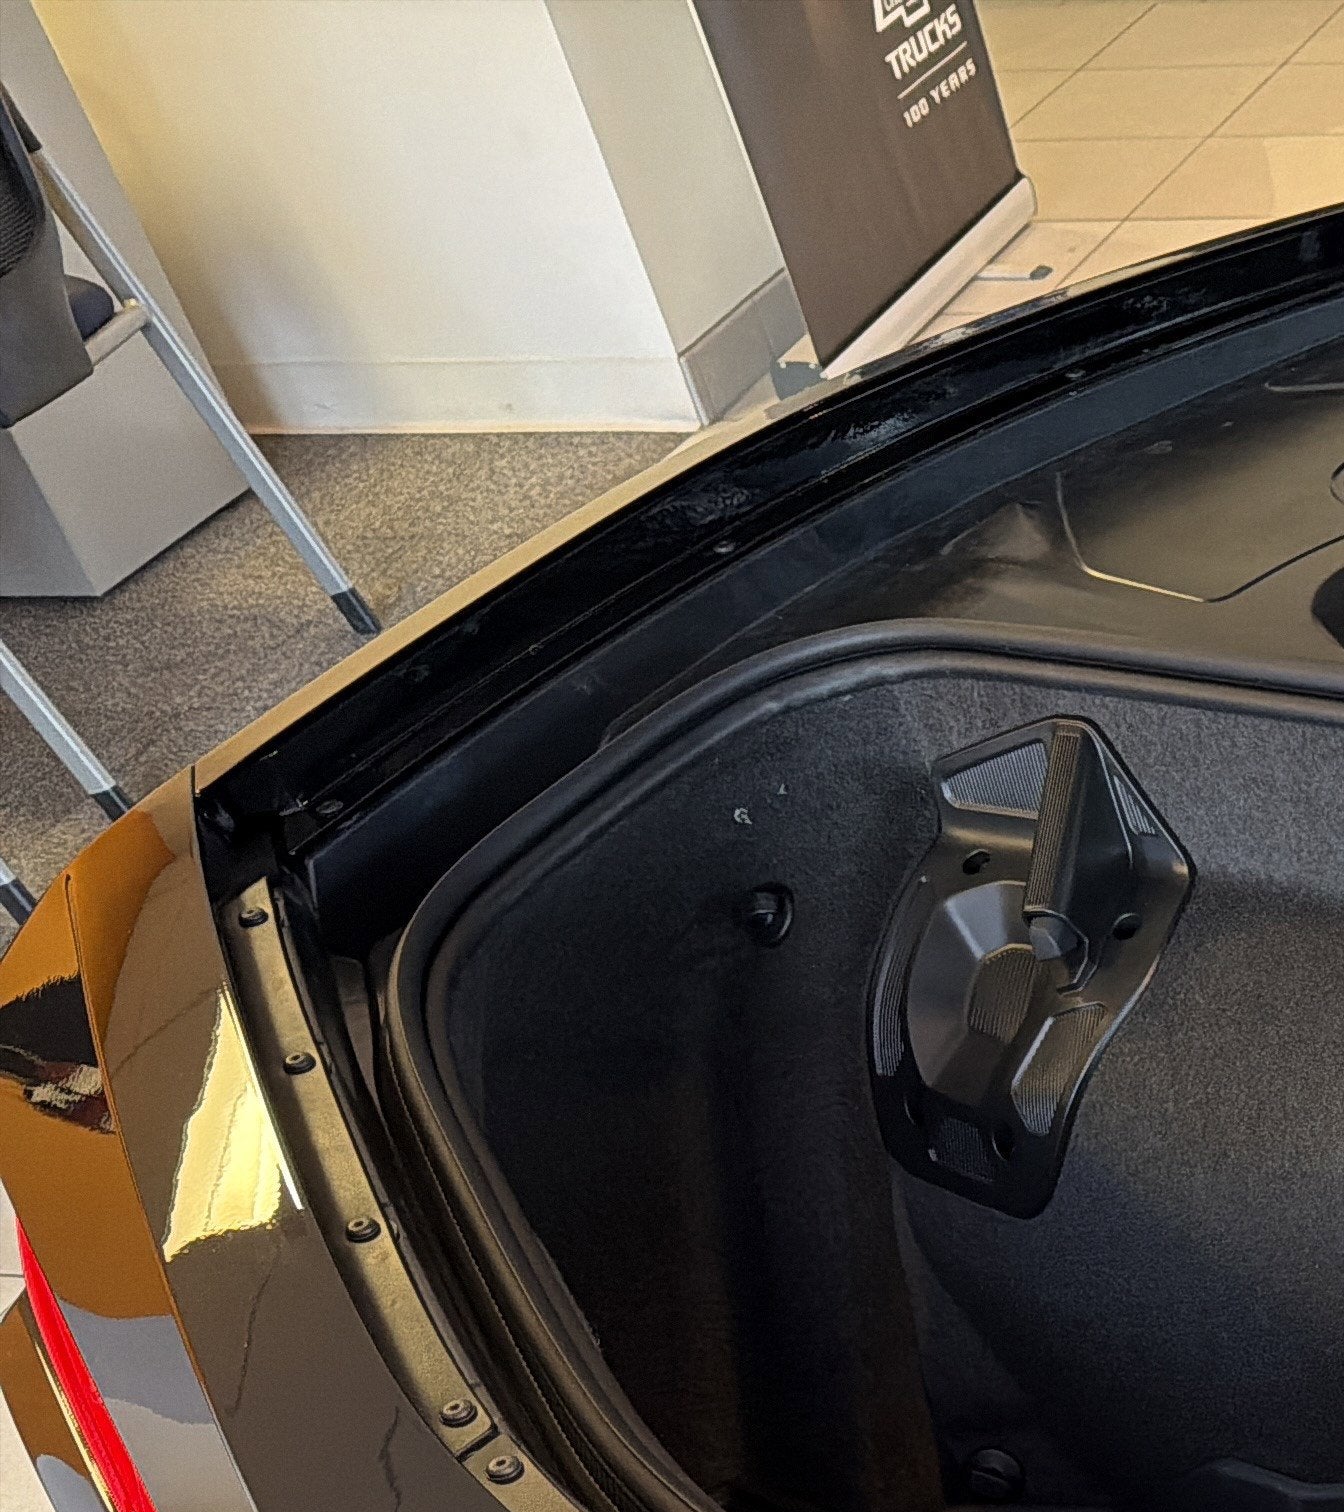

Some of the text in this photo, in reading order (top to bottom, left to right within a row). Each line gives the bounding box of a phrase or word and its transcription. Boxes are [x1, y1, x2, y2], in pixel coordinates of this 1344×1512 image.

[885, 3, 962, 80] TRUCKS
[903, 57, 976, 128] 100 YEARS
